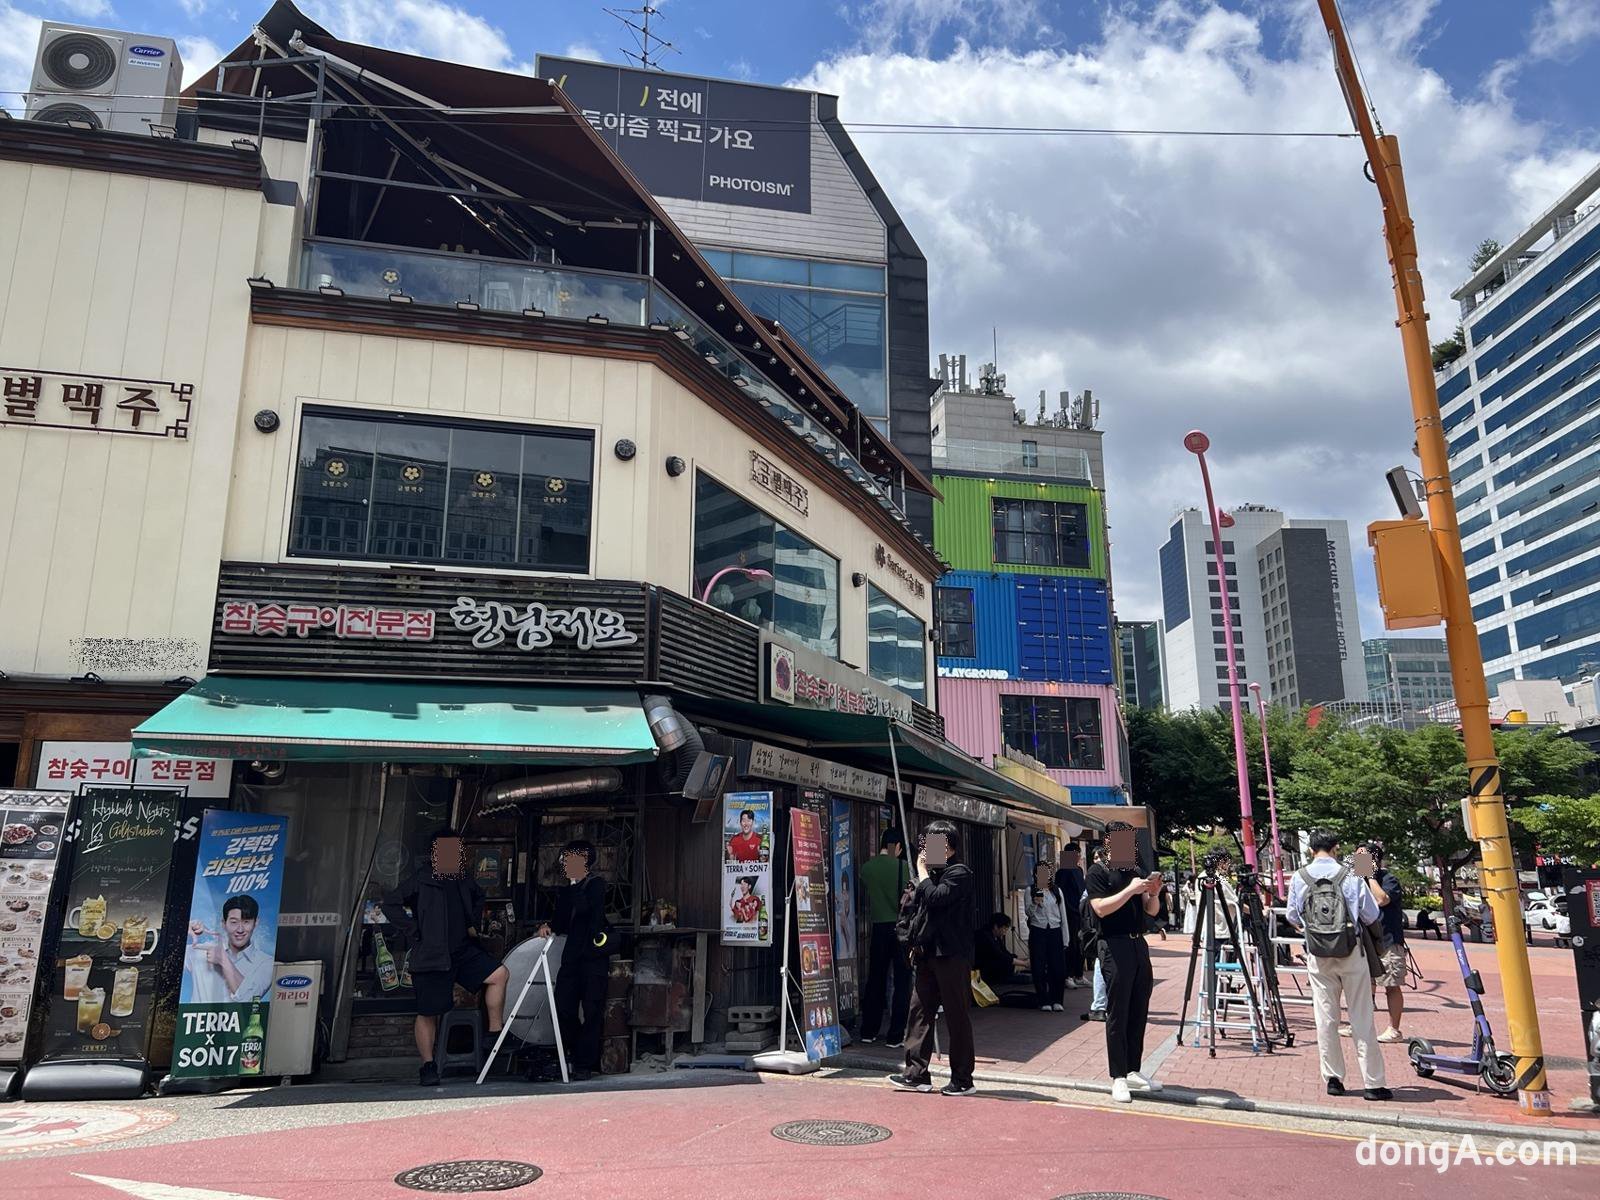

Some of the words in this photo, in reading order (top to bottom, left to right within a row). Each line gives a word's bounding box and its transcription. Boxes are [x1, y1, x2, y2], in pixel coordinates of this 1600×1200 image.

[133, 47, 161, 57] Carrier
[656, 88, 702, 115] 전에
[657, 119, 703, 144] 찍고
[709, 127, 755, 151] 가요
[710, 175, 791, 197] PHOTOISM
[1327, 540, 1340, 589] Mercure
[1337, 631, 1348, 661] HOTEL
[222, 601, 435, 642] 참숯구이전문점
[937, 666, 1009, 680] PLAYGROUND
[47, 757, 131, 780] 참숯구이
[151, 759, 216, 781] 전문점
[136, 800, 171, 823] Nights
[225, 833, 279, 856] 강력한
[202, 853, 274, 877] 리얼탄산
[726, 864, 744, 874] TERRA
[225, 872, 270, 894] 100%
[280, 977, 308, 987] Carrier
[276, 991, 310, 1000] 캐리어
[182, 1011, 241, 1035] TERRA
[241, 1042, 262, 1053] TERRA
